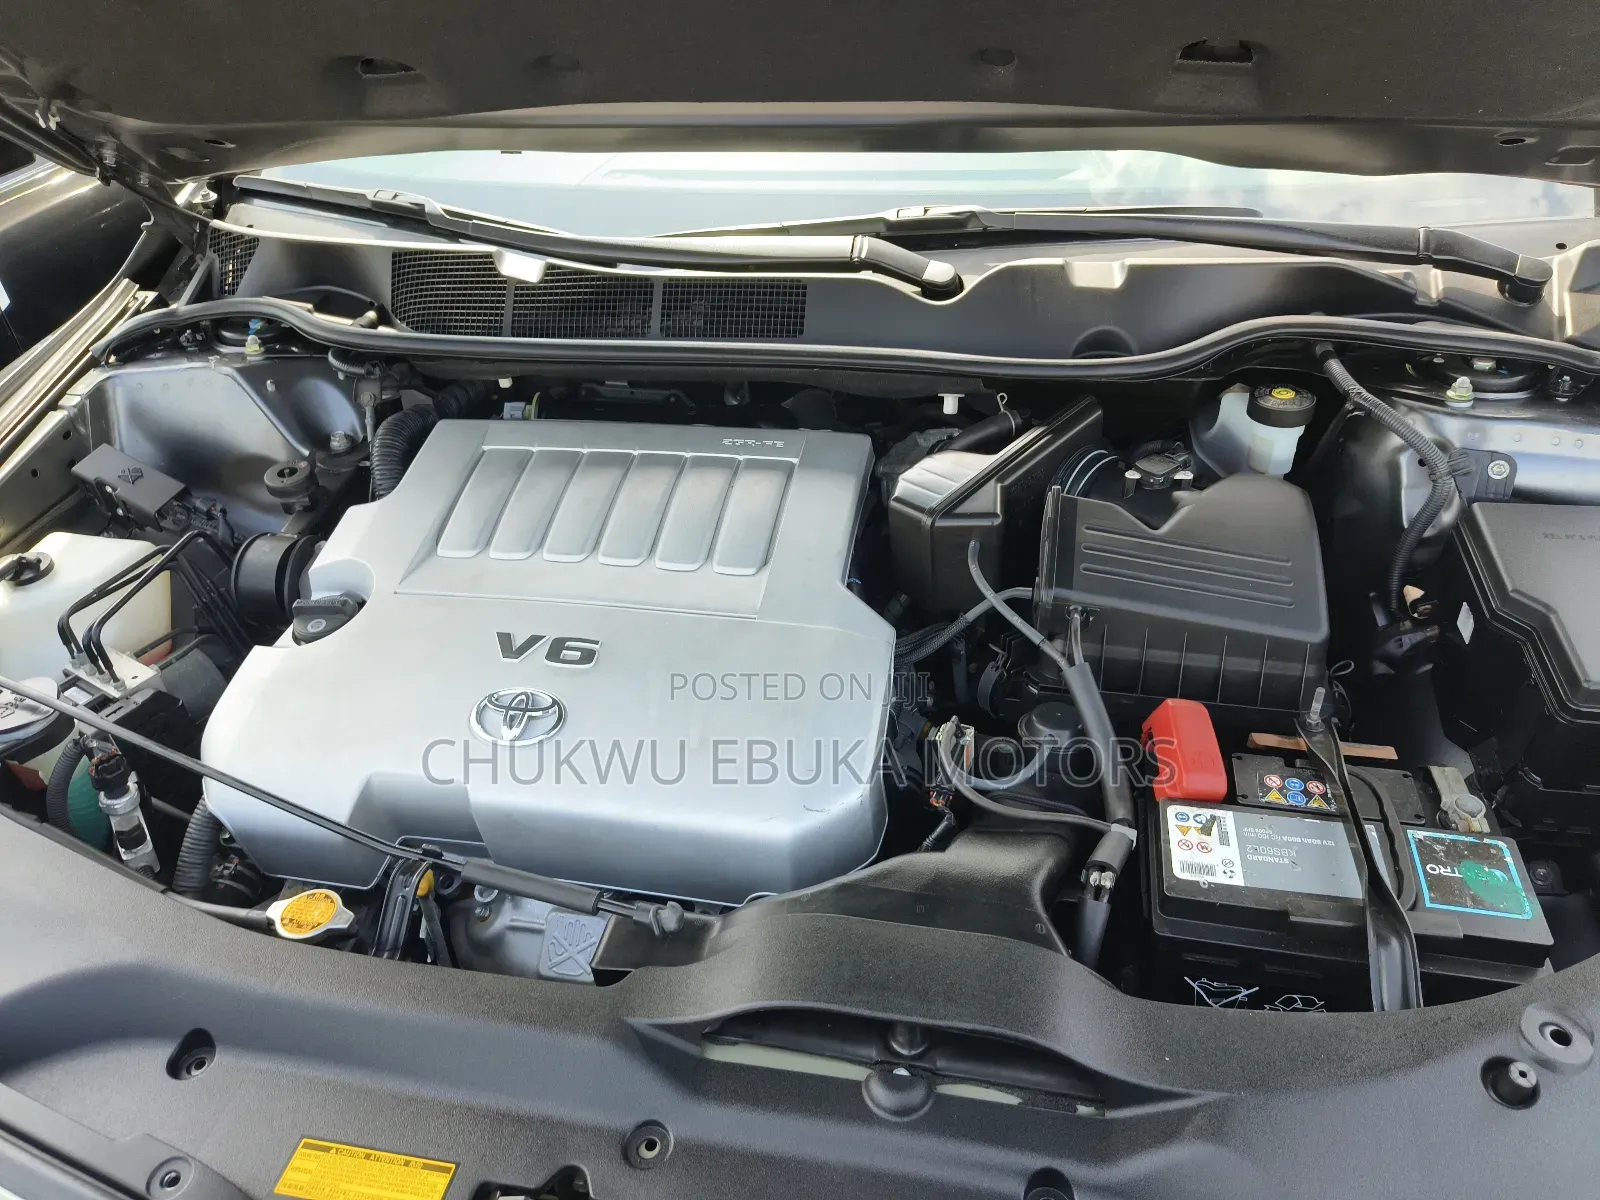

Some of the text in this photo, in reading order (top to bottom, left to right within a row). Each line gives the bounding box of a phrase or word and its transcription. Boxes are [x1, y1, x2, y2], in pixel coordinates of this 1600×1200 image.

[495, 631, 603, 669] V6
[1246, 844, 1297, 858] KBS60L2
[1247, 854, 1289, 864] STANDARD
[337, 1148, 366, 1160] CAUTION
[369, 1153, 406, 1166] ATTENTION
